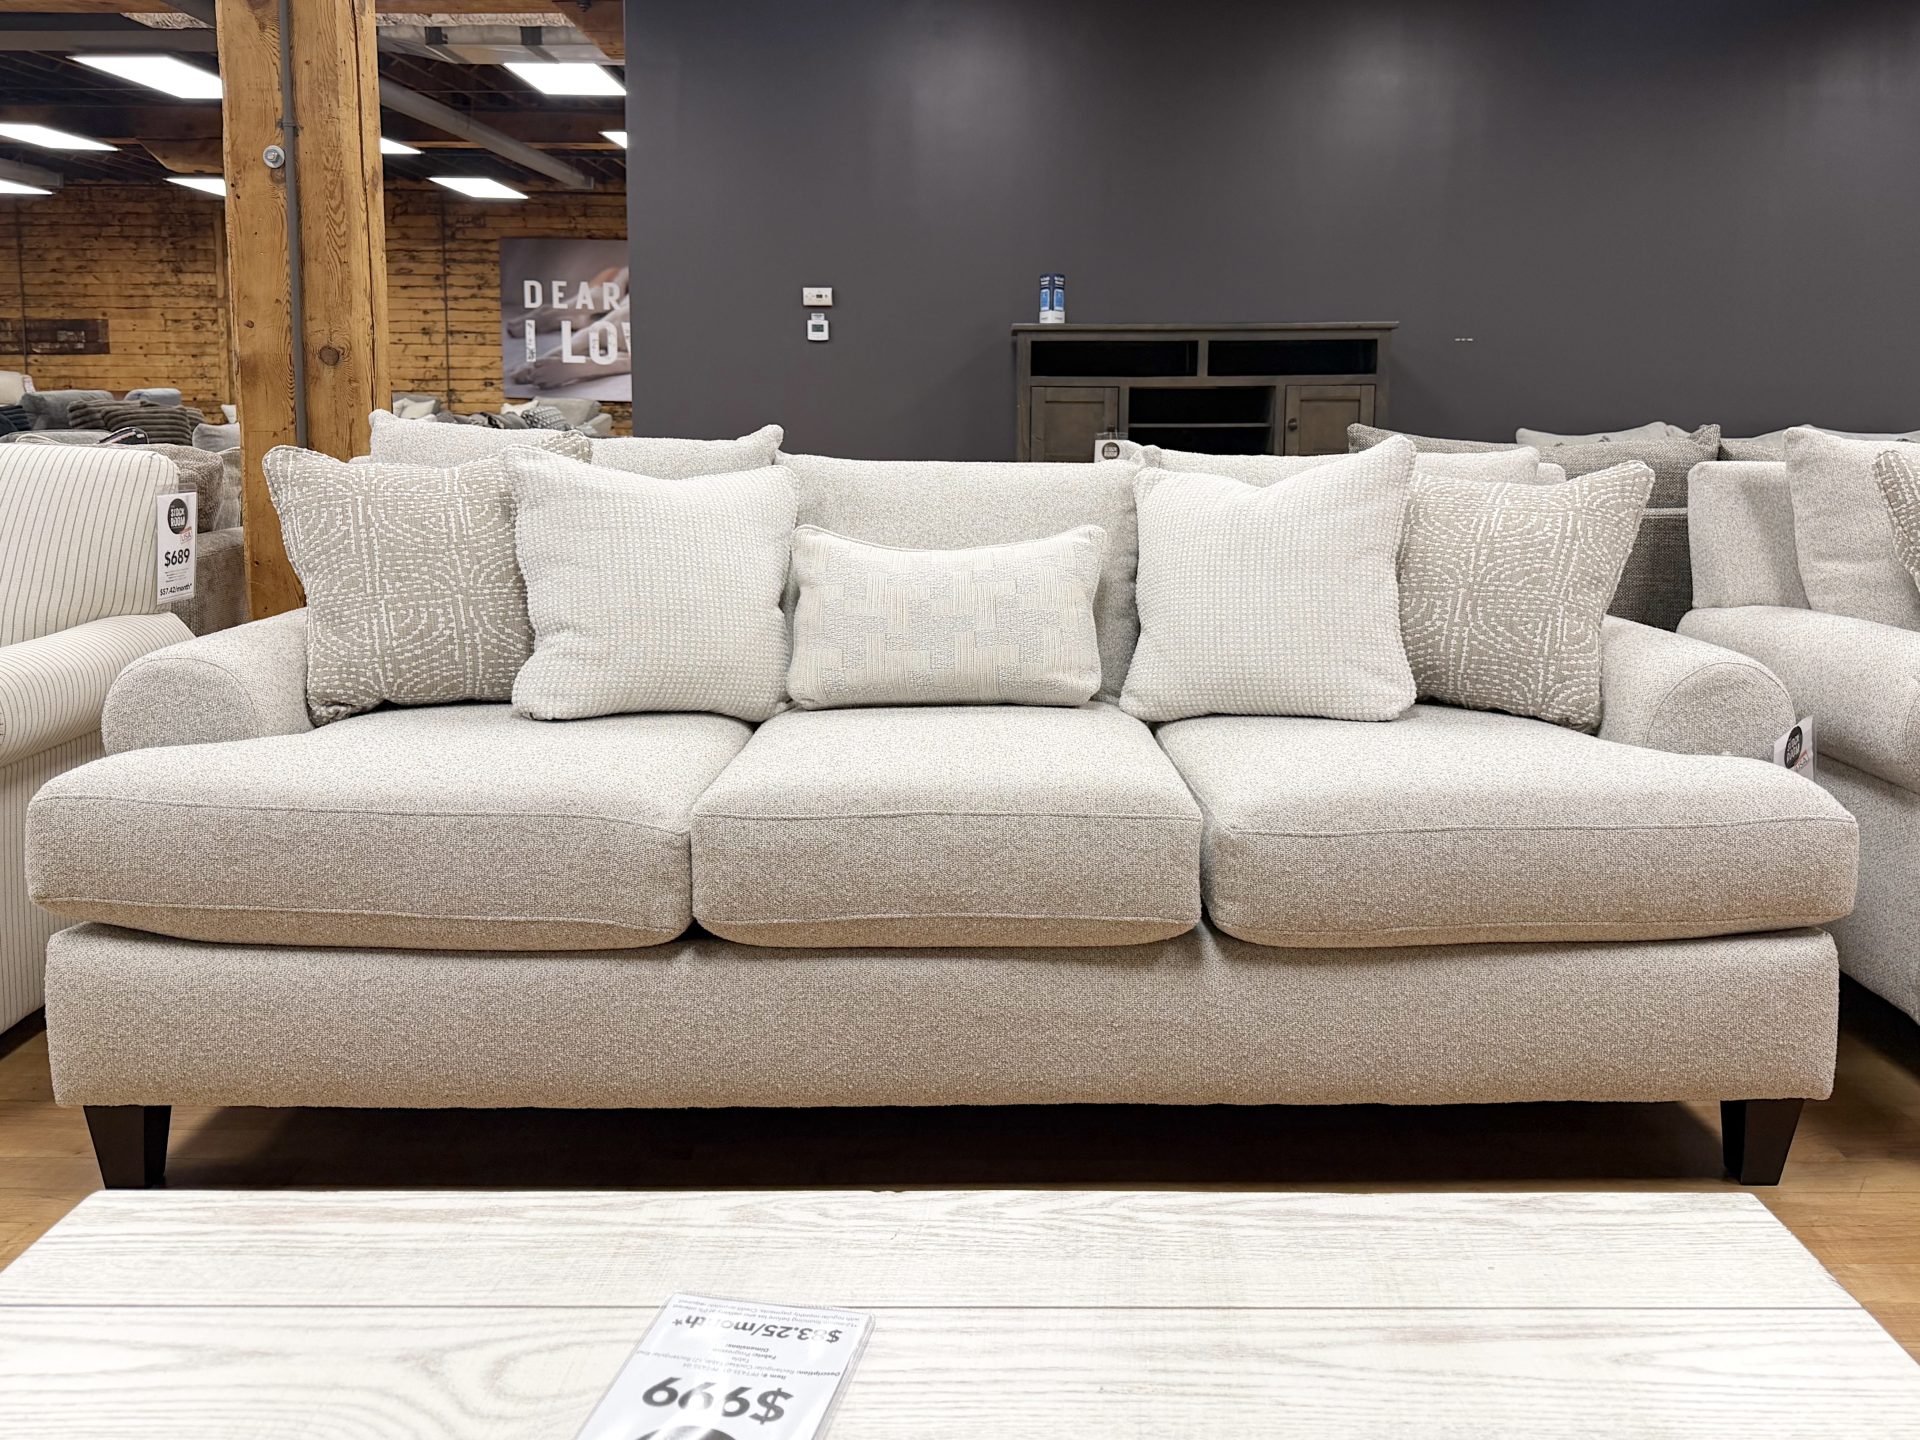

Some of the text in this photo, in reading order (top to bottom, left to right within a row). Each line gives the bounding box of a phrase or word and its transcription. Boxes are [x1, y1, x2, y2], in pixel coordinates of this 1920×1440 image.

[523, 280, 621, 310] DEAR
[525, 319, 536, 362] I
[170, 508, 185, 517] STOCK
[170, 517, 185, 527] ROOM
[164, 548, 190, 567] $689
[672, 1316, 842, 1344] $83.25/moth
[726, 1344, 769, 1352] Dimensions:
[754, 1366, 795, 1374] Rectangular
[642, 1377, 794, 1426] $999
